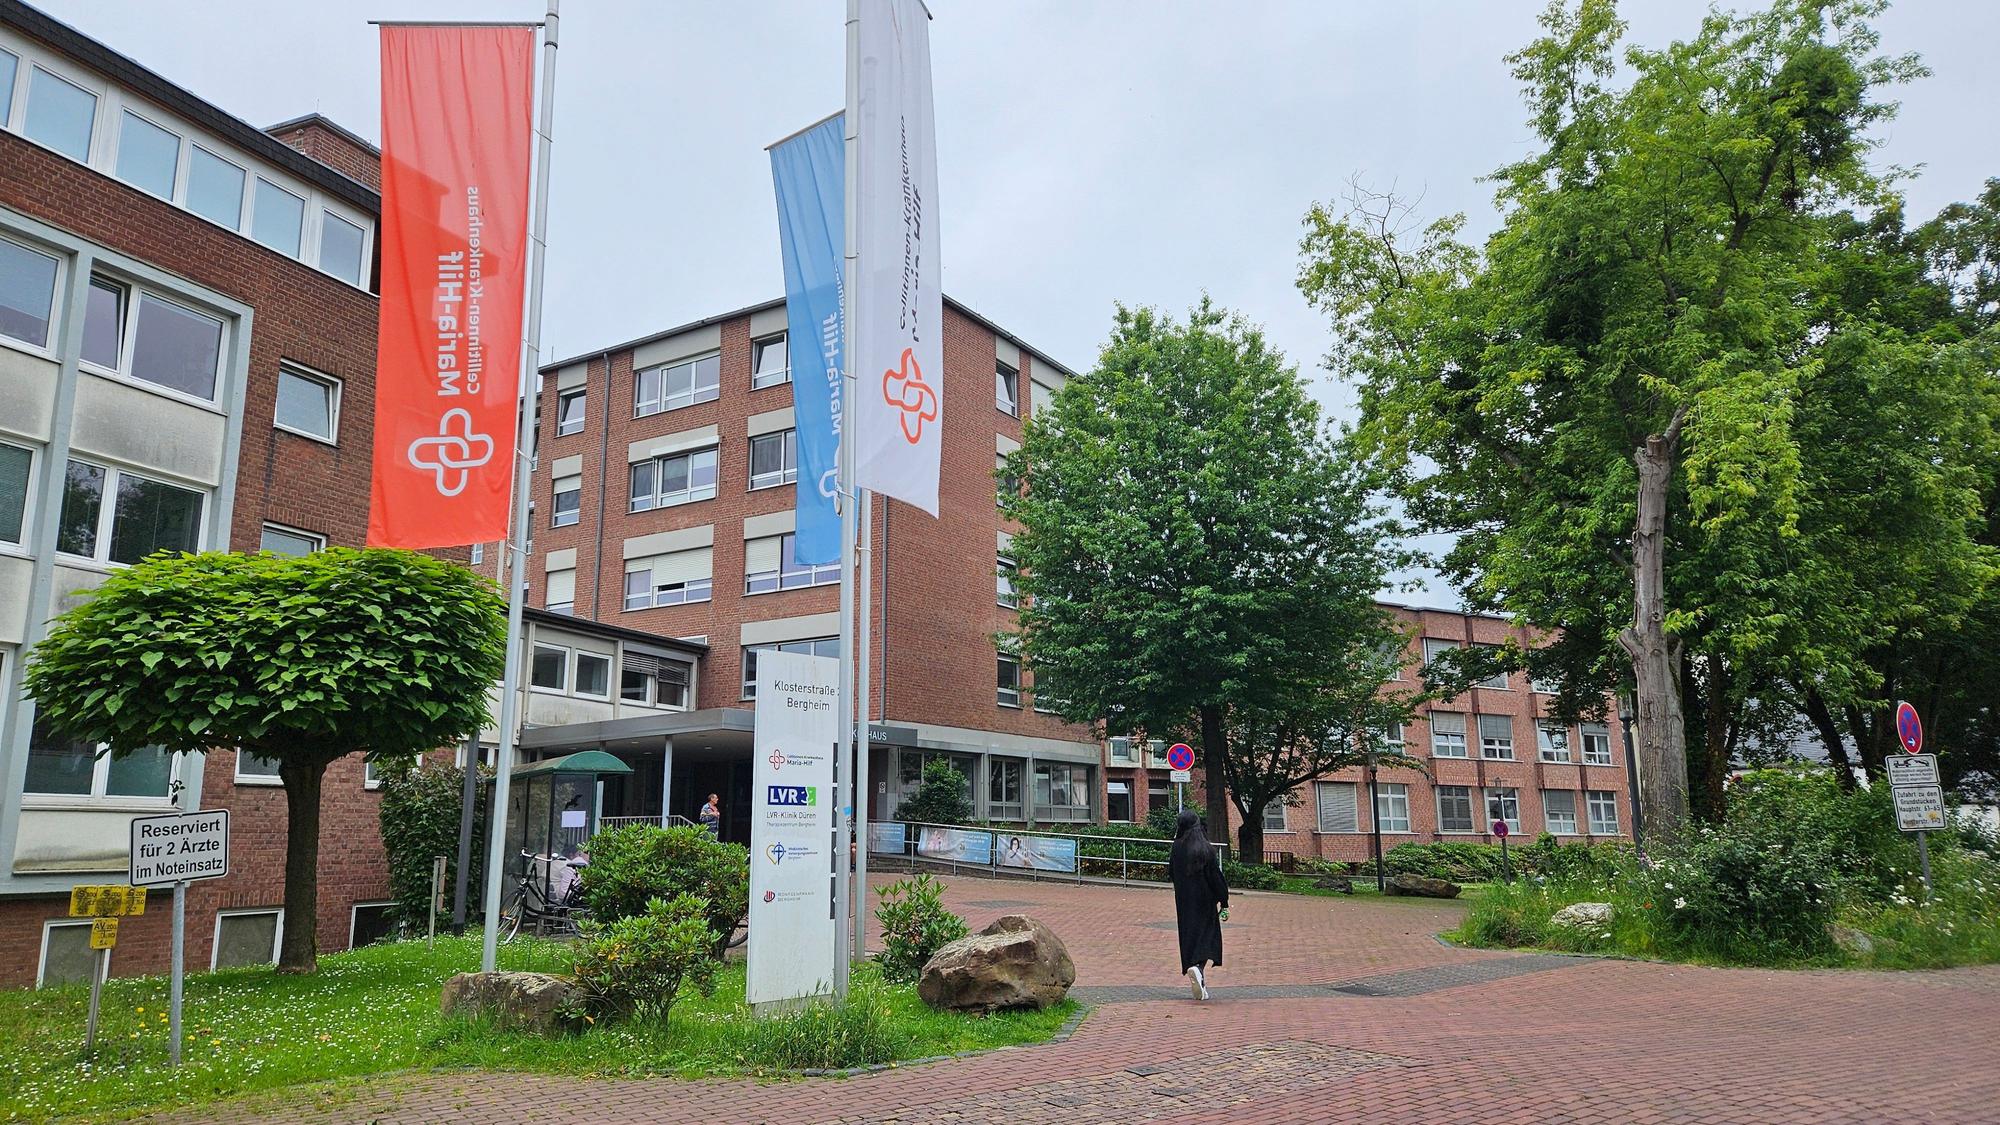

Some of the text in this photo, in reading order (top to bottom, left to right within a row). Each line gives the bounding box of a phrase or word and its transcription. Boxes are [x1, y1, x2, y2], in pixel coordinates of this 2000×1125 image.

[774, 679, 835, 696] Klosterstraße
[787, 697, 830, 711] Bergheim
[770, 788, 798, 803] LVR
[766, 811, 798, 819] LVR-Klinik
[799, 811, 816, 819] Düren
[141, 818, 220, 838] Reserviert
[140, 838, 220, 858] für 2 Ärzte
[136, 858, 222, 879] im Noteinsatz
